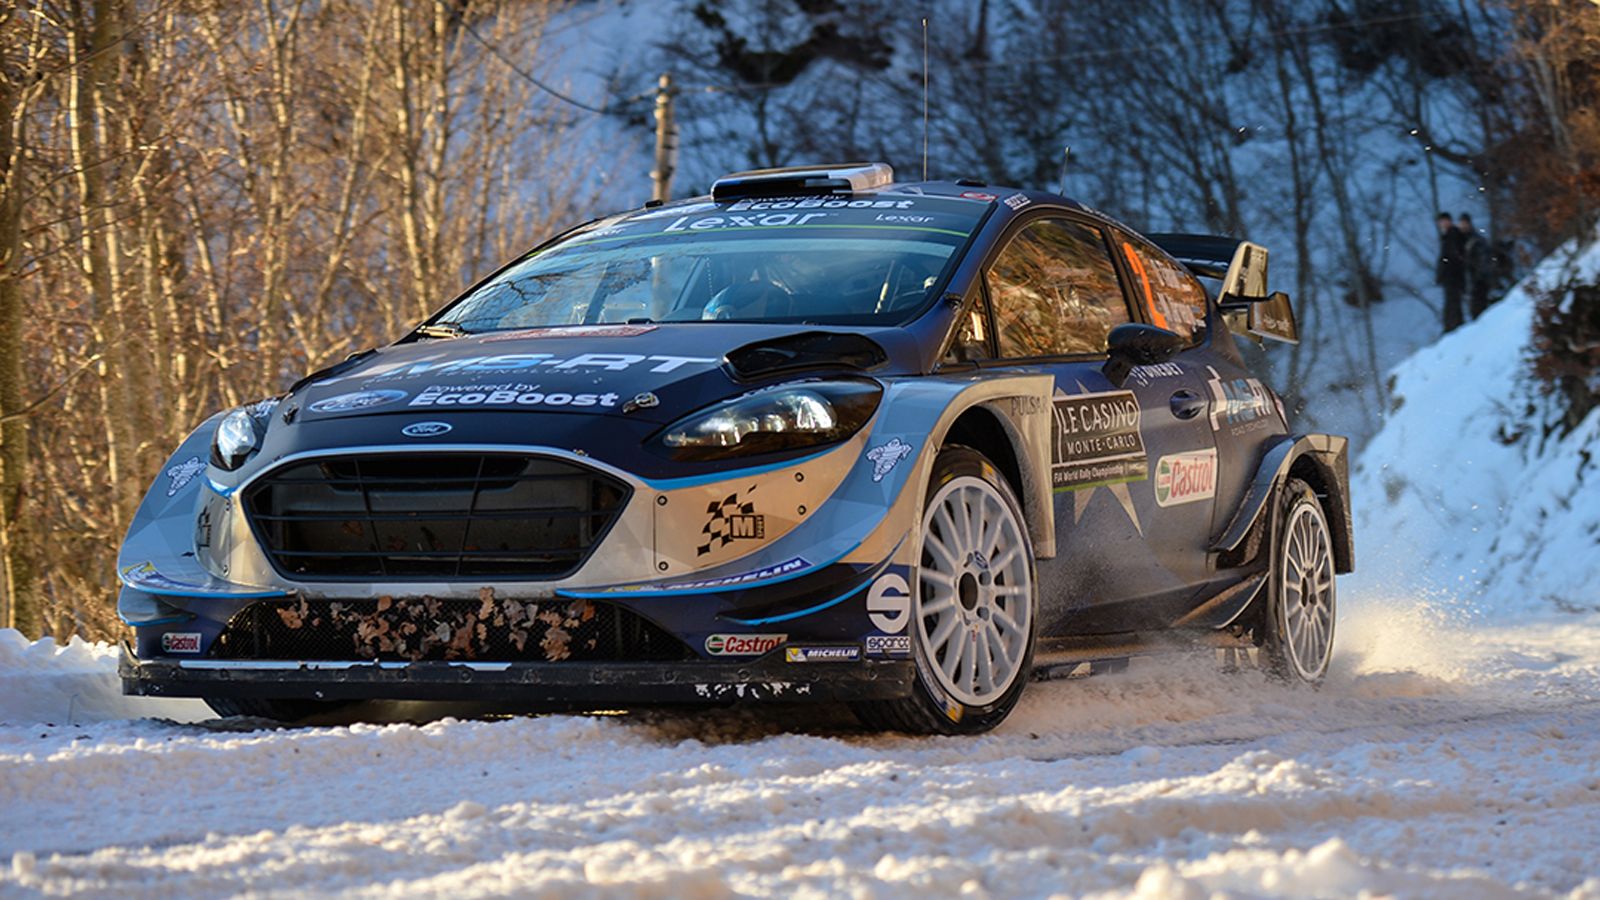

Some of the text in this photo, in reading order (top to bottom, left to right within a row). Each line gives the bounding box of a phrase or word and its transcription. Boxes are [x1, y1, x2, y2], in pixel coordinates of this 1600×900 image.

[726, 199, 914, 211] EcoBoost
[664, 212, 827, 232] Lexar
[875, 213, 934, 223] Lexar
[424, 383, 541, 394] Powered by
[408, 391, 620, 407] EcoBoost
[1058, 400, 1137, 434] LE CASINO
[1171, 454, 1214, 498] Castrol
[806, 649, 858, 658] MICHELIN
